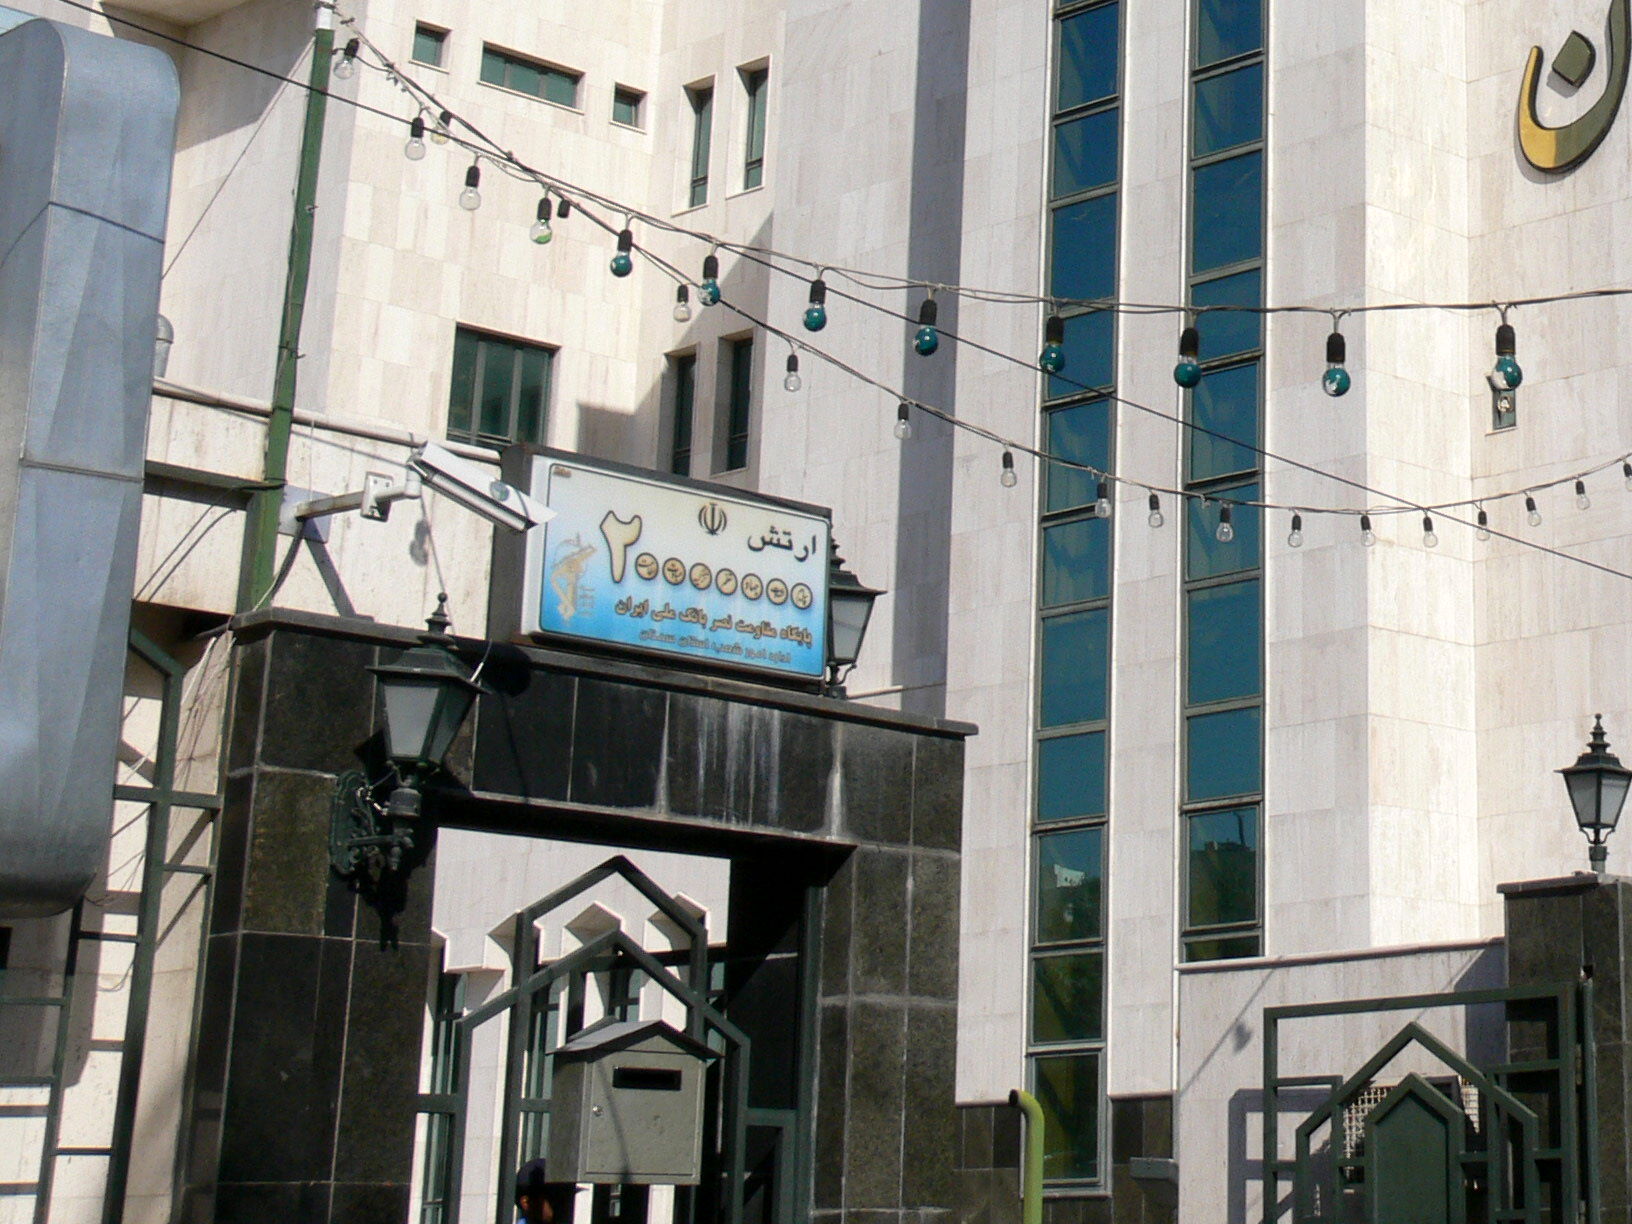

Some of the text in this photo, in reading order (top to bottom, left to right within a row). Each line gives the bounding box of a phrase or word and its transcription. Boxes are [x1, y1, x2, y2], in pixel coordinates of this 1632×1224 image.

[747, 525, 818, 563] ارتش
[614, 595, 650, 618] ایران
[651, 601, 677, 622] ملی
[679, 607, 708, 630] بانک
[735, 619, 778, 640] مقاومت
